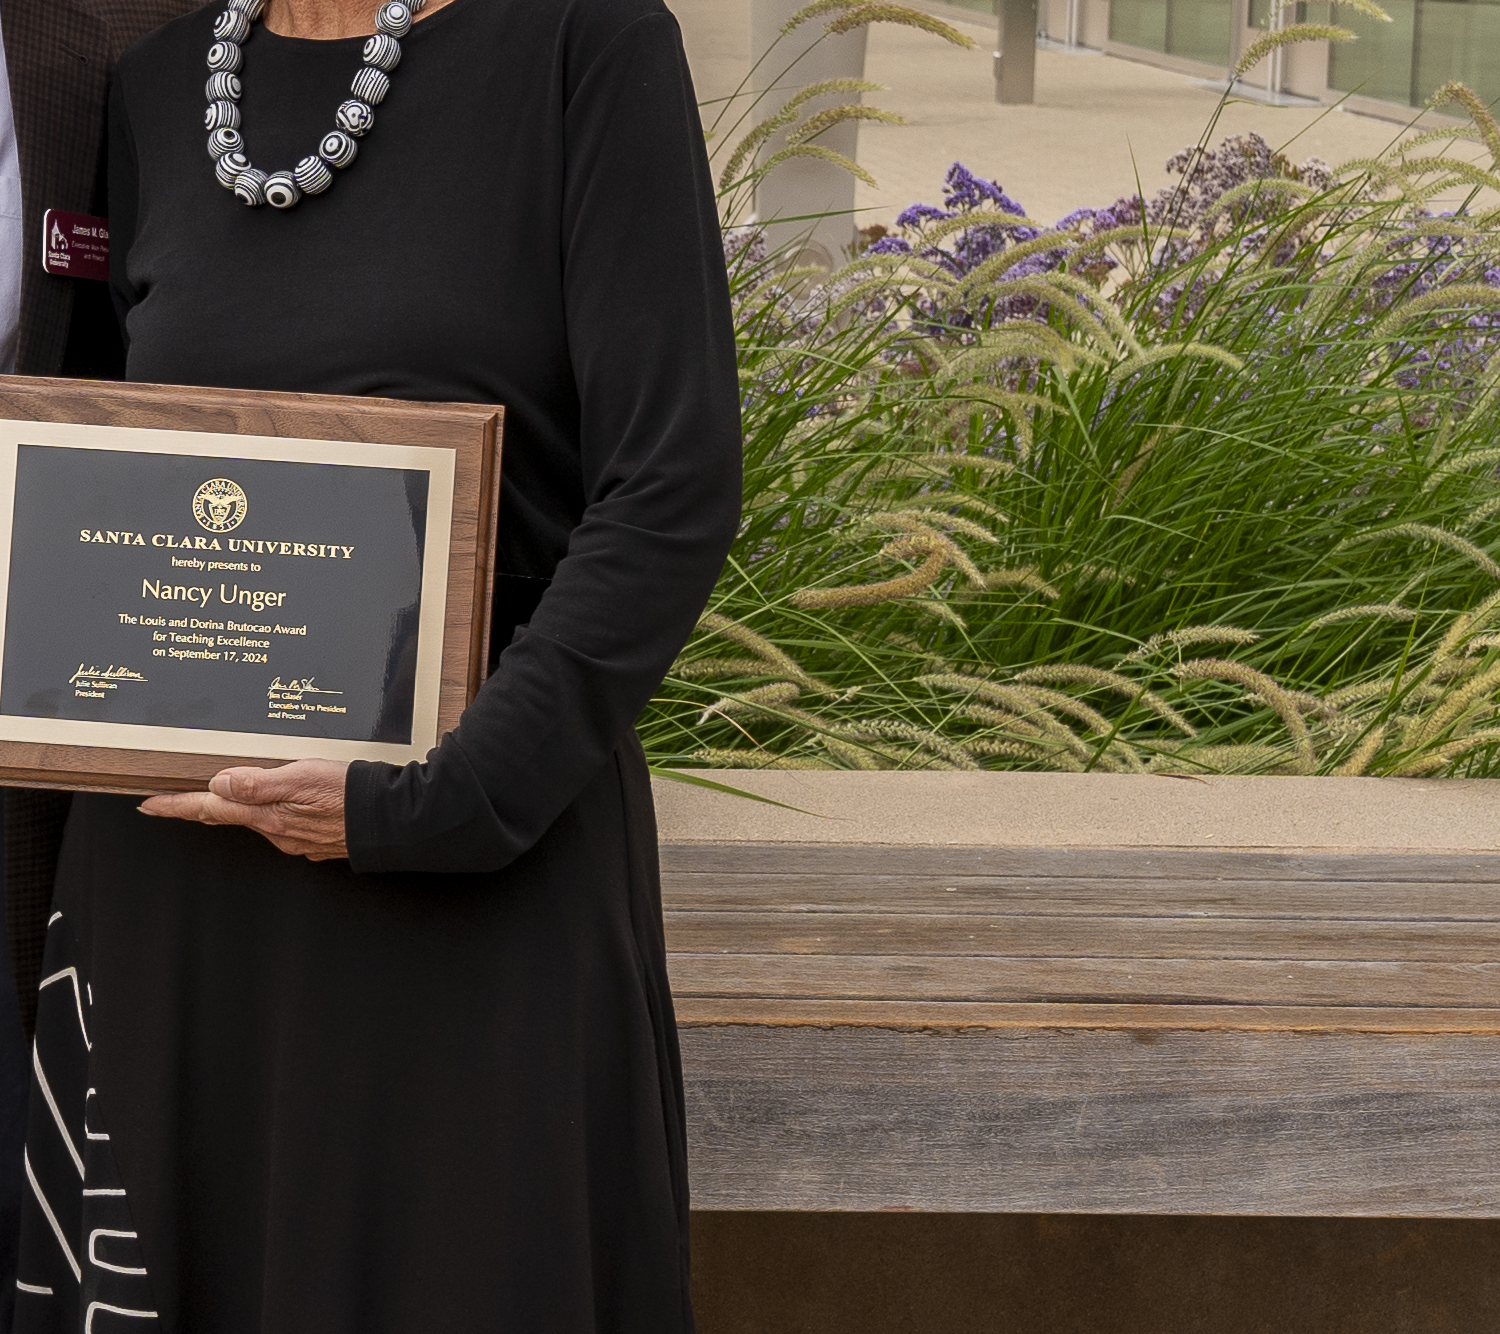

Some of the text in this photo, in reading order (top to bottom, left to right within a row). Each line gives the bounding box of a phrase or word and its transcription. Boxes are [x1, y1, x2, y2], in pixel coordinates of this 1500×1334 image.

[79, 529, 355, 559] SANTA CLARA UNIVERSITY
[171, 556, 261, 573] hereby presents to
[142, 578, 286, 612] Nancy Unger
[118, 613, 307, 636] The Louis and Dorina Brutocao Award
[152, 631, 270, 649] for Teaching Excellence
[152, 647, 268, 663] on September 17, 2024
[75, 690, 105, 698] President
[269, 702, 299, 710] Executive
[317, 705, 347, 713] President
